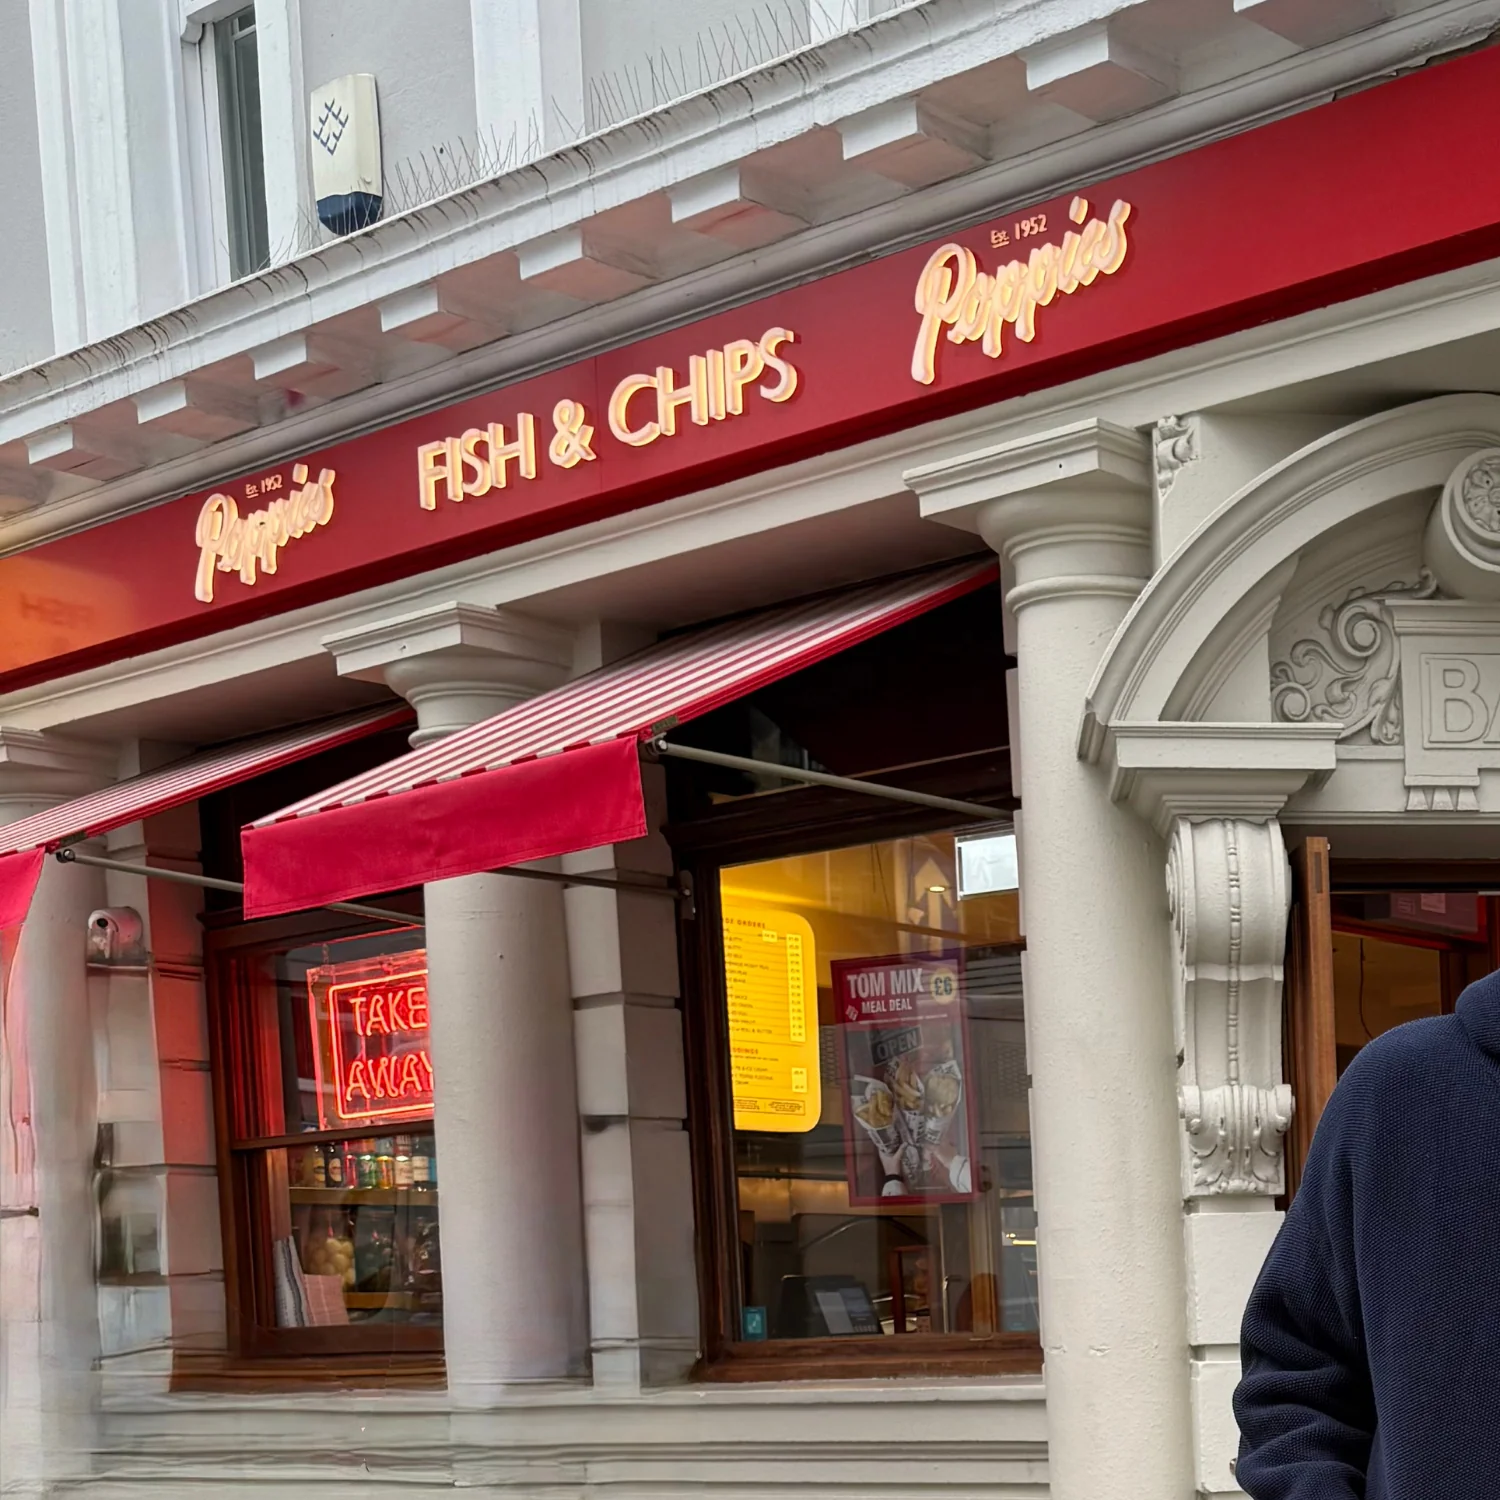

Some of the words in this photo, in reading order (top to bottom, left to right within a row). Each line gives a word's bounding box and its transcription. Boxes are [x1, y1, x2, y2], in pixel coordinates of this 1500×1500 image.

[1014, 214, 1048, 240] 1952
[911, 196, 1132, 385] Poppies
[417, 411, 536, 511] FISH
[548, 398, 598, 469] &
[607, 326, 798, 447] CHIPS
[194, 463, 336, 603] Poppies
[847, 972, 886, 998] TOM
[890, 968, 924, 995] MIX
[934, 976, 953, 996] £6
[349, 987, 428, 1036] TAKE
[861, 1001, 887, 1014] MEAL
[889, 998, 912, 1011] DEAL
[876, 1030, 918, 1060] OPEN
[346, 1051, 434, 1101] AWAY
